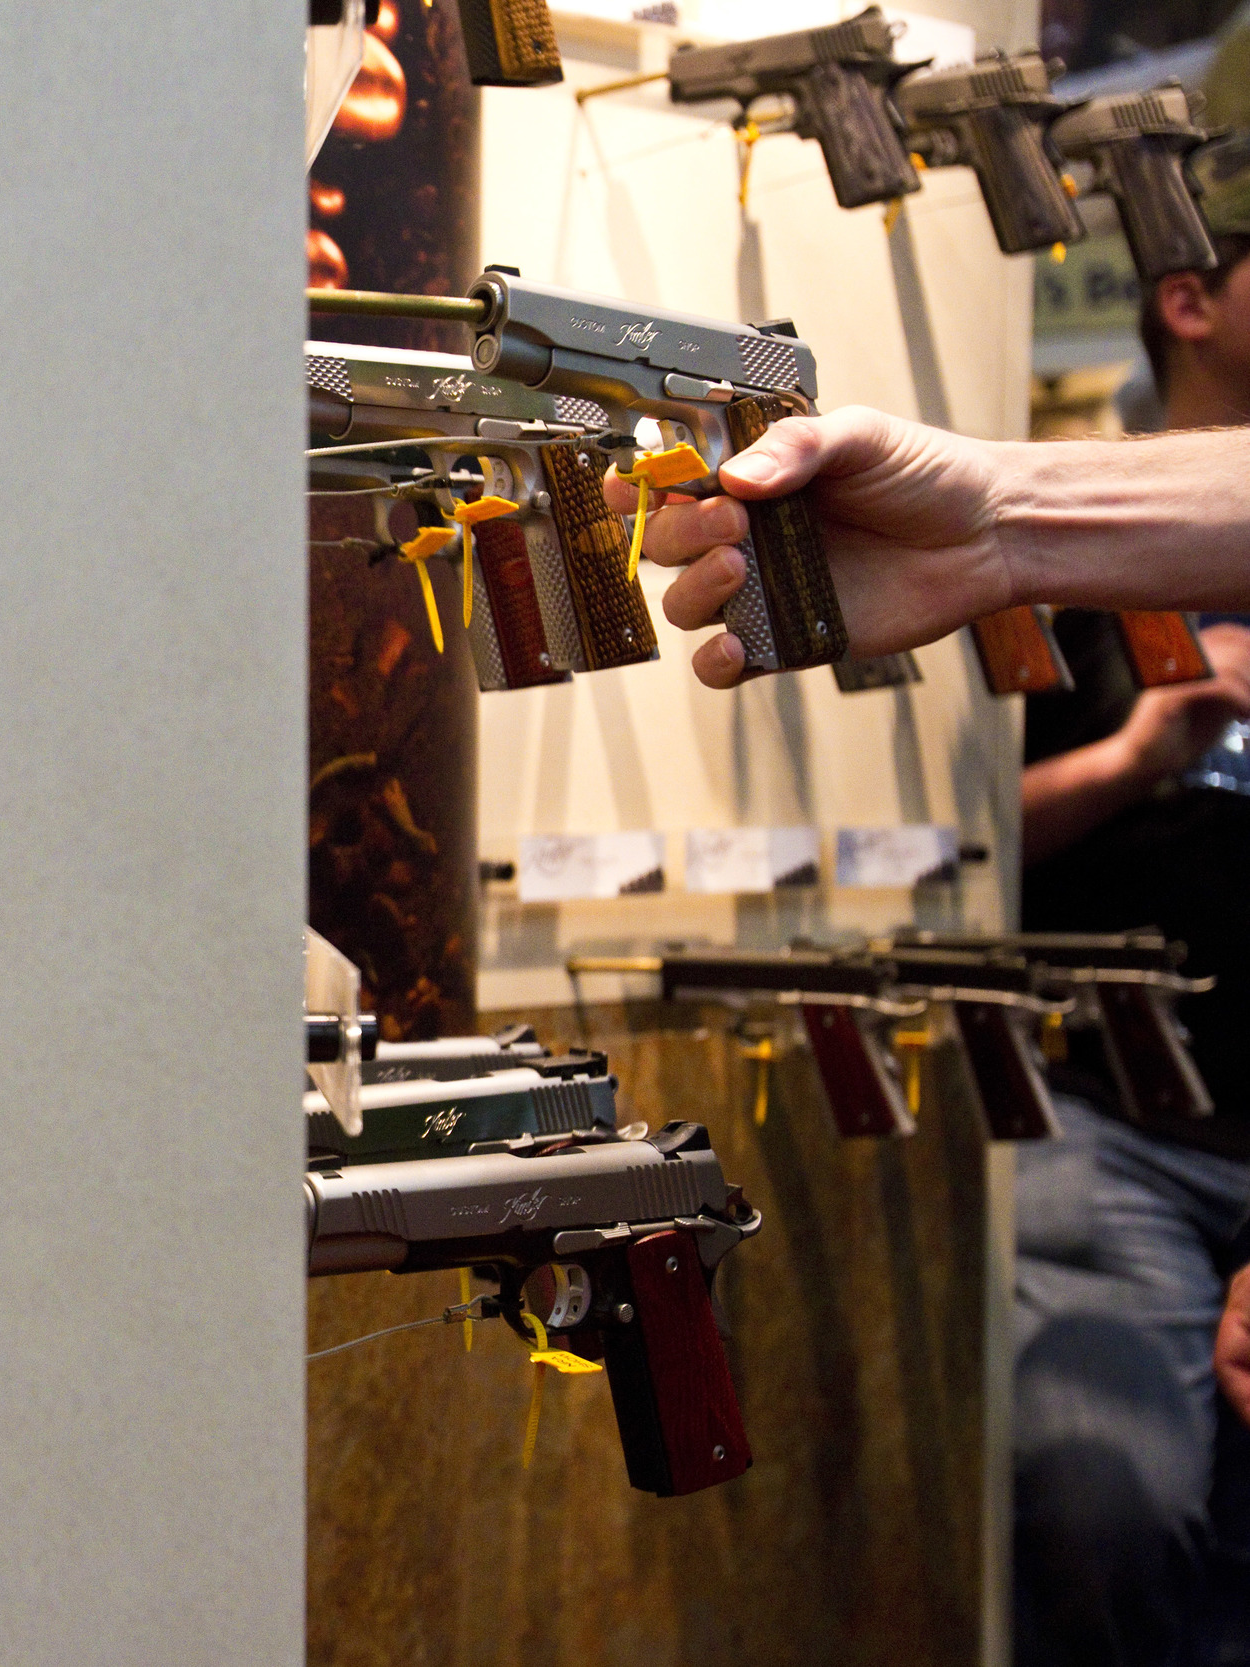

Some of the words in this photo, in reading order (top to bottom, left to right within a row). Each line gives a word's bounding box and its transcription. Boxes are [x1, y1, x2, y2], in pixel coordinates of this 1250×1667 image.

[612, 320, 663, 351] Kimber
[426, 373, 476, 402] Kimber
[421, 1106, 467, 1142] Kimber
[498, 1187, 549, 1224] Kimber
